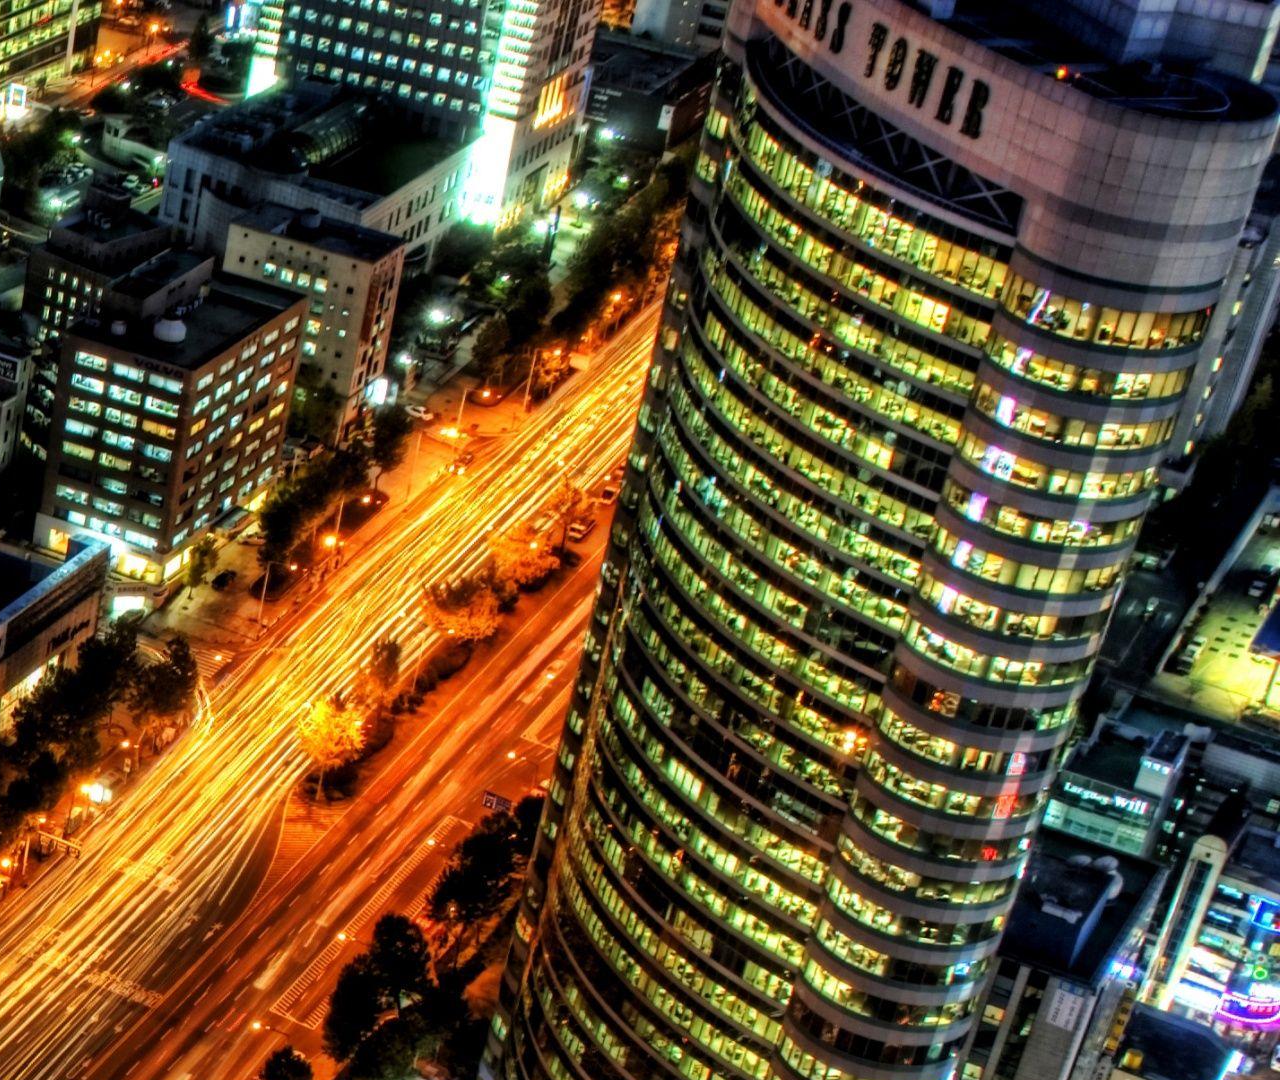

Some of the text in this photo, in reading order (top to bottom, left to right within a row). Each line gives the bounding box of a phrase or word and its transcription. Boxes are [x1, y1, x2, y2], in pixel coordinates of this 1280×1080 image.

[773, 0, 990, 140] ASS TOWER
[135, 357, 184, 379] VOLVO
